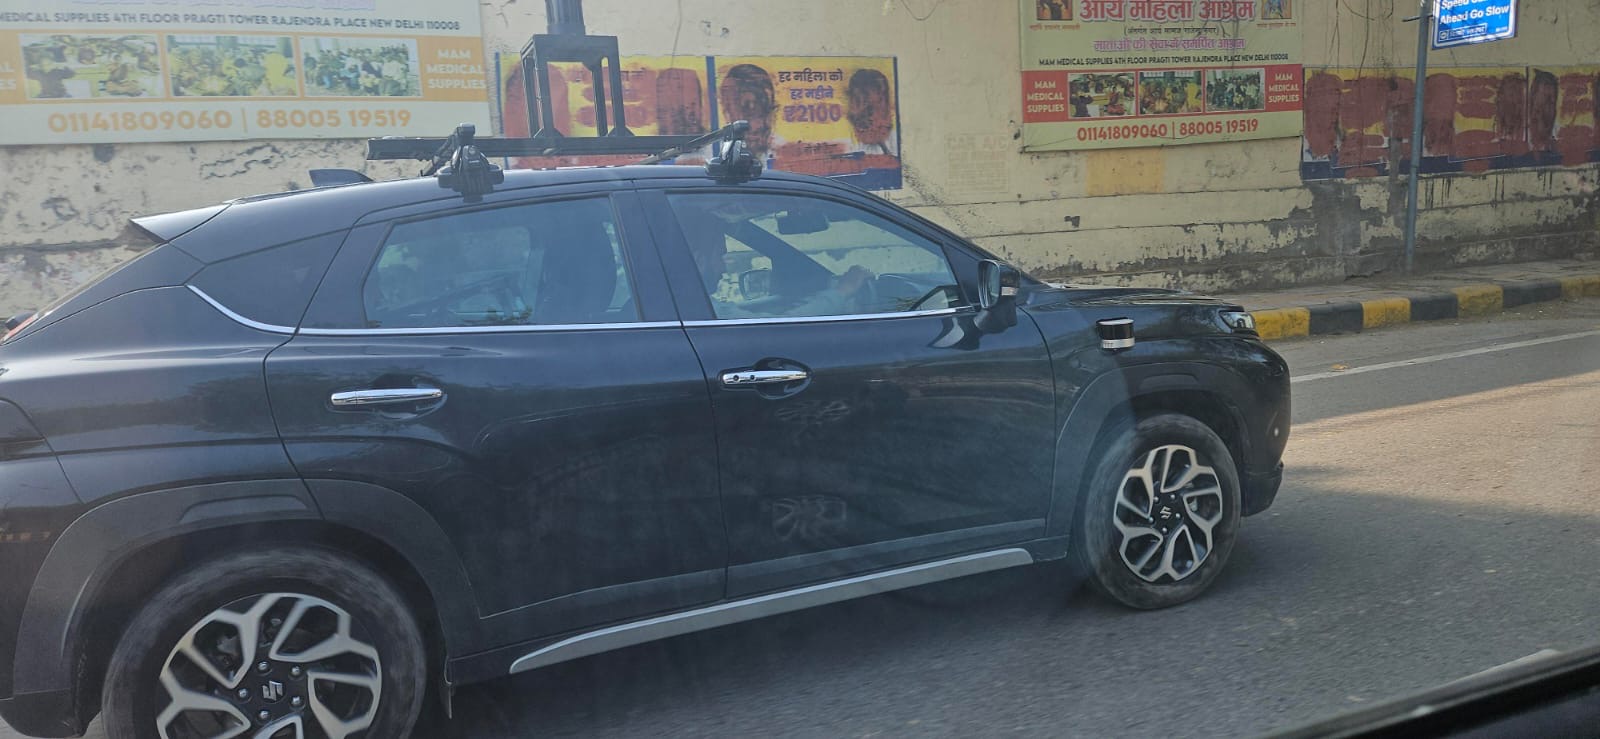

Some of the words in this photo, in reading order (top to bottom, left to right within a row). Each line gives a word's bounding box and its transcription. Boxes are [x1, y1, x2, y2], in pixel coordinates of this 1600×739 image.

[1199, 0, 1254, 19] आश्रम
[1440, 11, 1468, 24] Ahead
[1470, 9, 1484, 19] Go
[1485, 5, 1510, 16] Slow
[54, 12, 110, 23] SUPPLIES
[113, 13, 137, 23] 4TH
[140, 13, 181, 23] FLOOR
[184, 14, 226, 24] PRAGTI
[229, 14, 269, 25] TOWER
[271, 15, 330, 26] RAJENDRA
[333, 17, 367, 27] PLACE
[370, 18, 392, 28] NEW
[395, 19, 424, 29] DELHI
[426, 20, 461, 30] 110008
[437, 49, 471, 59] MAM
[1193, 55, 1222, 63] RAJENDRA
[1255, 53, 1270, 61] DELHI
[426, 64, 482, 74] MEDICAL
[778, 71, 791, 82] हर
[793, 67, 827, 82] महिला
[829, 68, 843, 81] को
[1275, 73, 1293, 81] MAM
[428, 79, 486, 89] SUPPLIES
[1034, 81, 1056, 89] MAM
[1268, 84, 1299, 92] MEDICAL
[790, 88, 802, 99] हर
[804, 85, 833, 99] महीने
[1027, 92, 1064, 101] MEDICAL
[1268, 95, 1300, 103] SUPPLIES
[784, 103, 842, 123] ₹2100
[1027, 104, 1064, 113] SUPPLIES
[48, 109, 232, 132] 01141809060
[256, 109, 341, 129] 88005
[349, 109, 411, 128] 19519
[1077, 124, 1167, 141] 01141809060
[1179, 120, 1222, 136] 88005
[1226, 118, 1258, 133] 19519
